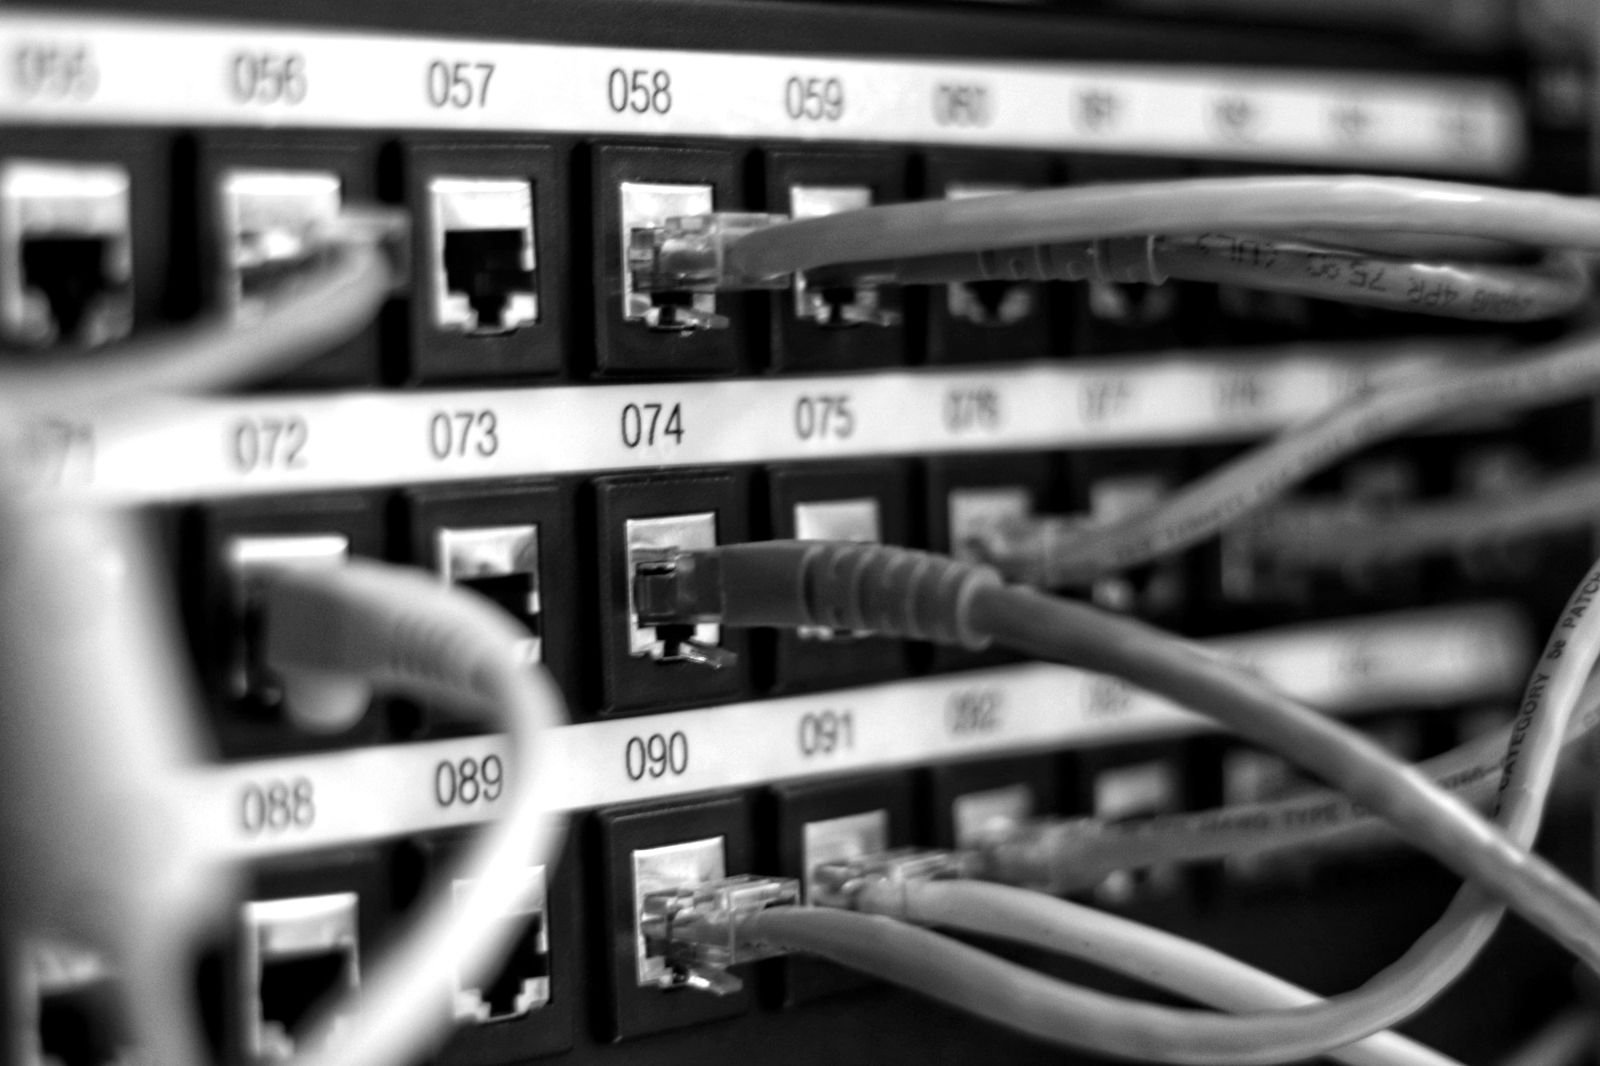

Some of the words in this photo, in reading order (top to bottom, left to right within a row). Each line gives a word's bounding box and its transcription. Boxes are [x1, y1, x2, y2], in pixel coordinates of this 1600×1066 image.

[226, 50, 307, 104] 056
[426, 60, 496, 109] 057
[607, 67, 673, 115] 058
[784, 76, 846, 122] 059
[229, 413, 309, 474] 072
[429, 408, 499, 460] 073
[621, 403, 685, 449] 074
[794, 393, 855, 441] 075
[1499, 672, 1550, 792] CATEGORY
[1547, 639, 1567, 661] 5e
[238, 775, 316, 835] 088
[434, 754, 504, 808] 089
[625, 731, 689, 782] 090
[798, 709, 855, 758] 091
